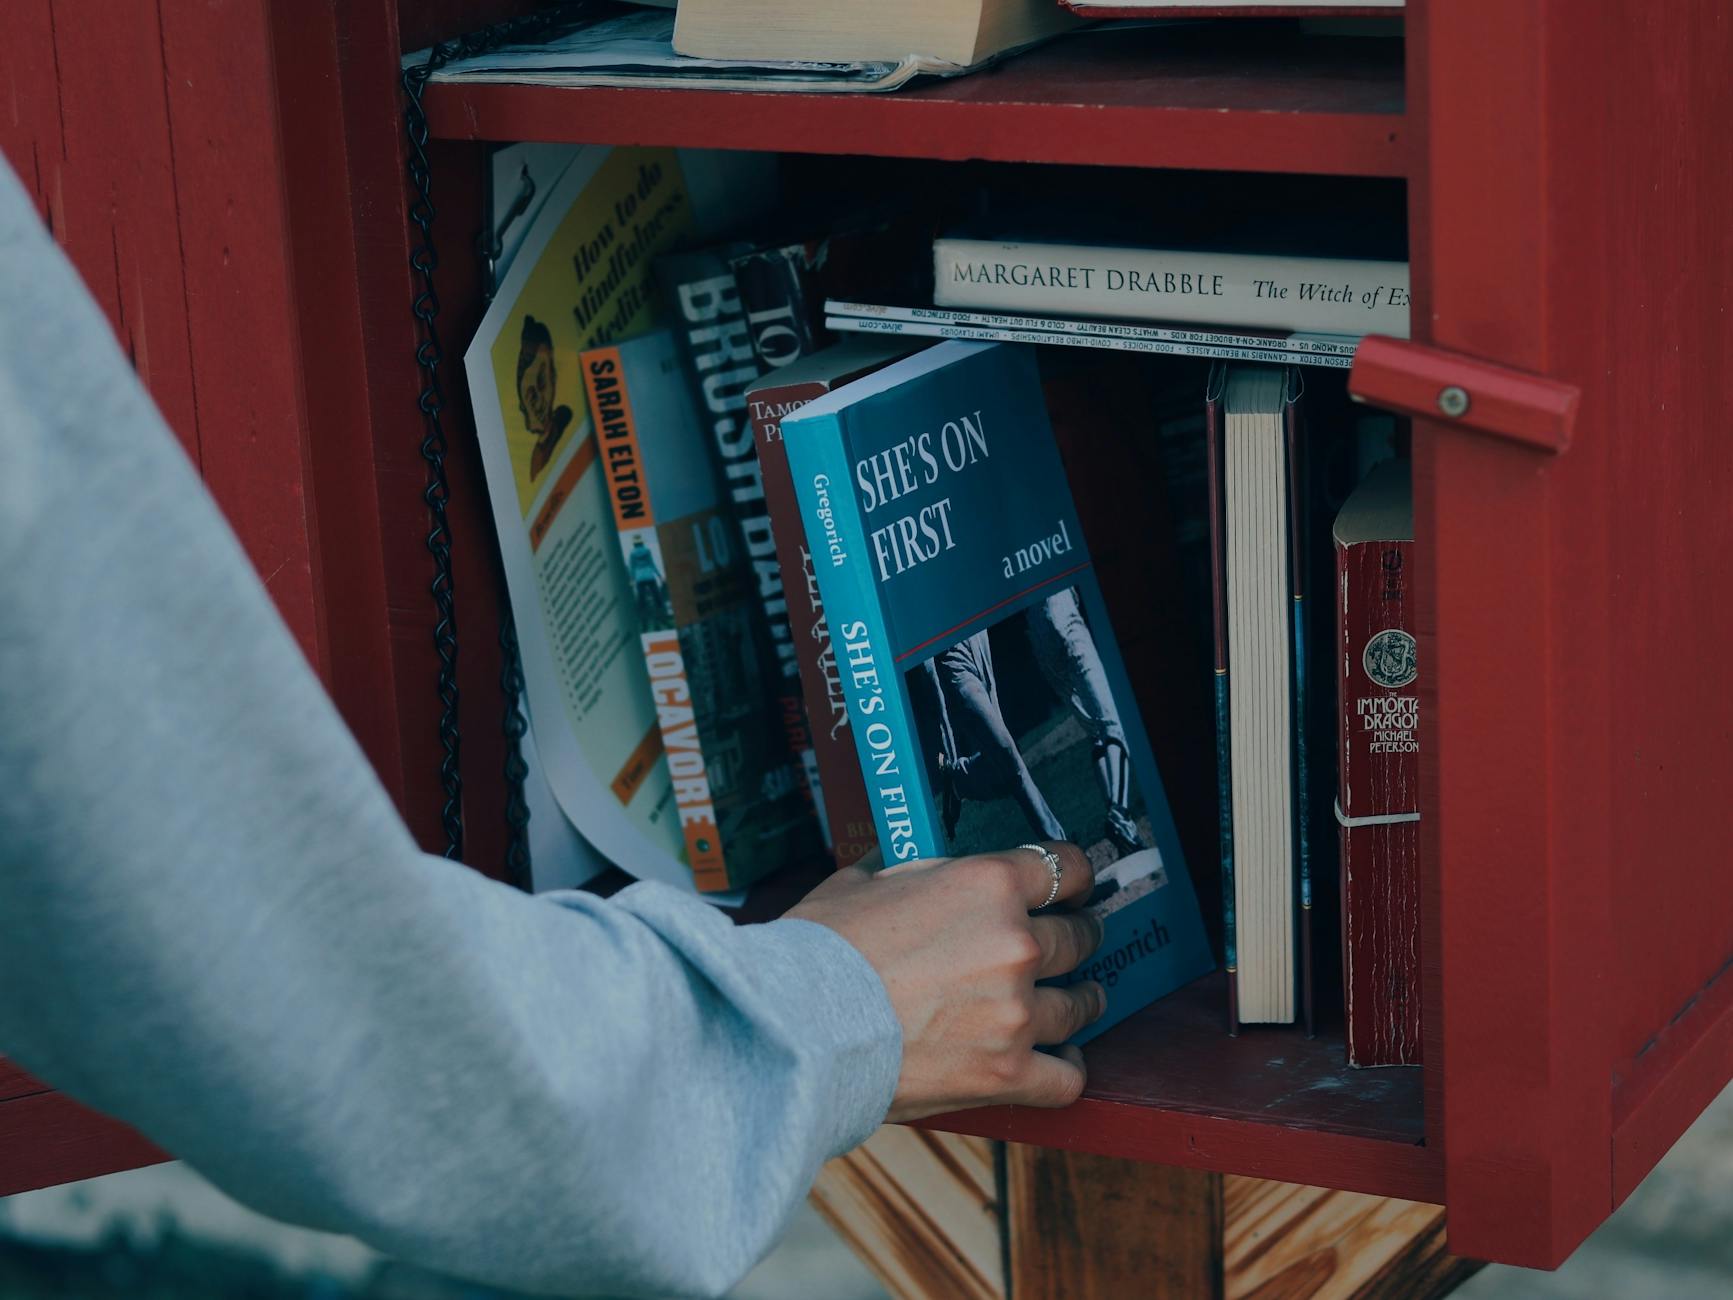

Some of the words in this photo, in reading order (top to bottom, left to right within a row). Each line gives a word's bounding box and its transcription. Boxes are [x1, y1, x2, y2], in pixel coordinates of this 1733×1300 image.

[573, 228, 614, 283] How
[615, 195, 637, 228] to
[638, 161, 662, 198] do
[573, 189, 684, 330] Mindfulness
[953, 262, 1095, 290] MARGARET
[1107, 268, 1224, 296] DRABBLE
[1252, 280, 1289, 299] The
[1299, 282, 1353, 303] Witch
[1361, 285, 1383, 310] of
[911, 309, 950, 319] EXTINCTION
[951, 312, 970, 321] FOOD
[981, 315, 1007, 324] HEALTH
[1009, 317, 1023, 325] GUT
[1025, 318, 1037, 326] FLU
[1047, 320, 1065, 329] COLD
[858, 320, 903, 333] alive.com
[939, 326, 974, 336] FLAVOURS
[1076, 323, 1106, 332] BEAUTY?
[1108, 326, 1130, 334] CLEAN
[975, 329, 999, 338] UMAMI
[1010, 332, 1063, 343] RELATIONSHIPS
[1170, 331, 1186, 339] KIDS
[1188, 333, 1203, 341] FOR
[1122, 340, 1153, 350] CHOICES
[1154, 343, 1173, 351] FOOD
[1311, 343, 1337, 351] AMONG
[1185, 346, 1210, 355] AISLES
[1212, 348, 1238, 357] BEAUTY
[1250, 351, 1287, 360] CANNABIS
[1299, 355, 1322, 363] DETOX
[1324, 357, 1352, 366] PERSON
[677, 273, 765, 503] BRUSH
[590, 360, 628, 440] SARAH
[750, 399, 811, 420] TAMO
[856, 431, 939, 513] SHE'S
[941, 410, 991, 473] ON
[608, 444, 645, 519] ELTON
[812, 473, 847, 568] Gregorich
[870, 497, 956, 583] FIRST
[1001, 556, 1013, 579] a
[1015, 519, 1073, 573] novel
[841, 620, 885, 715] SHE'S
[640, 629, 717, 826] LOCAVORE
[1373, 730, 1415, 742] MICHAEL
[866, 722, 900, 776] ON
[1369, 742, 1419, 754] PETERSON
[880, 784, 919, 861] FIRS
[1065, 917, 1171, 988] regorich
